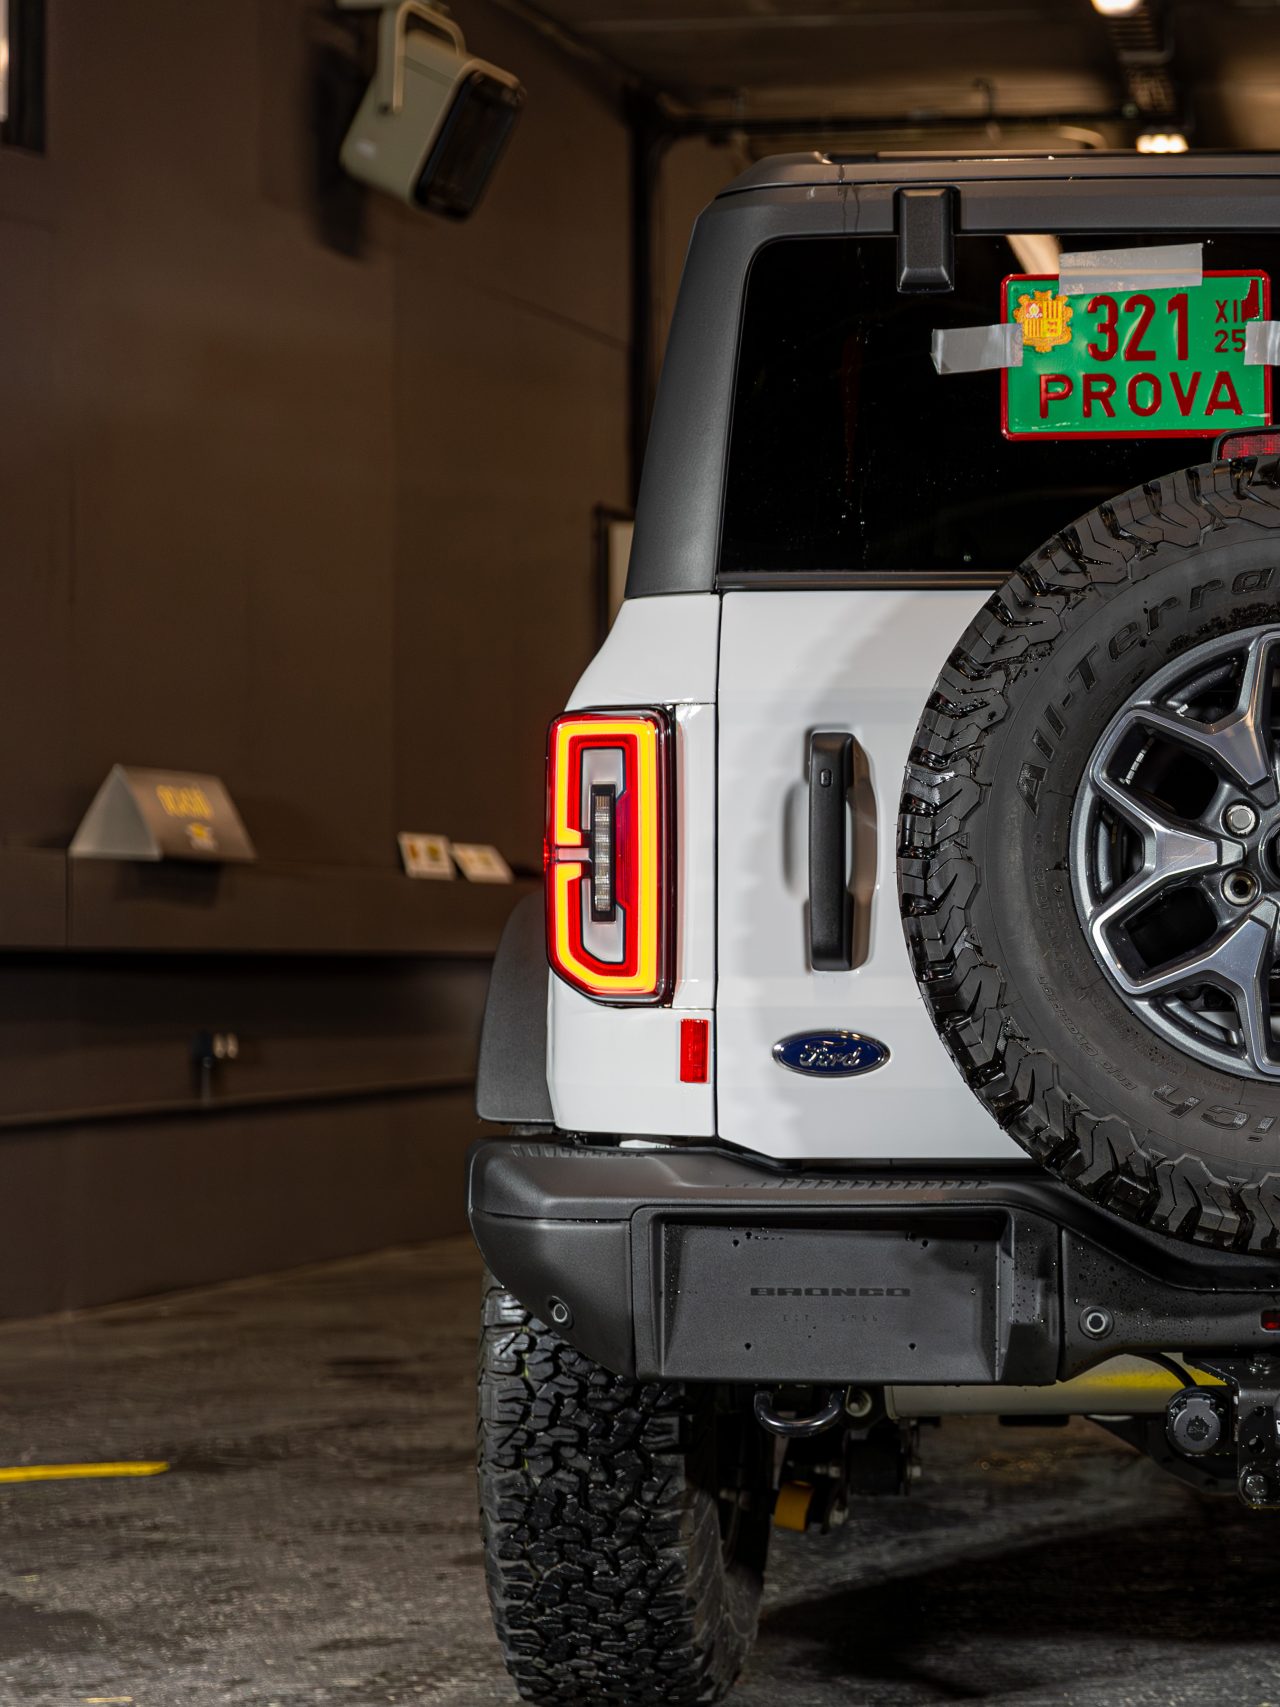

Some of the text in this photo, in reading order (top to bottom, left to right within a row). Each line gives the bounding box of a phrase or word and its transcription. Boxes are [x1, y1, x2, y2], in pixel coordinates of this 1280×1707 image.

[1087, 294, 1188, 361] 321
[1214, 329, 1246, 353] 25
[1039, 370, 1244, 418] PROVA
[800, 1040, 862, 1067] Ford
[749, 1286, 912, 1297] BRONCO
